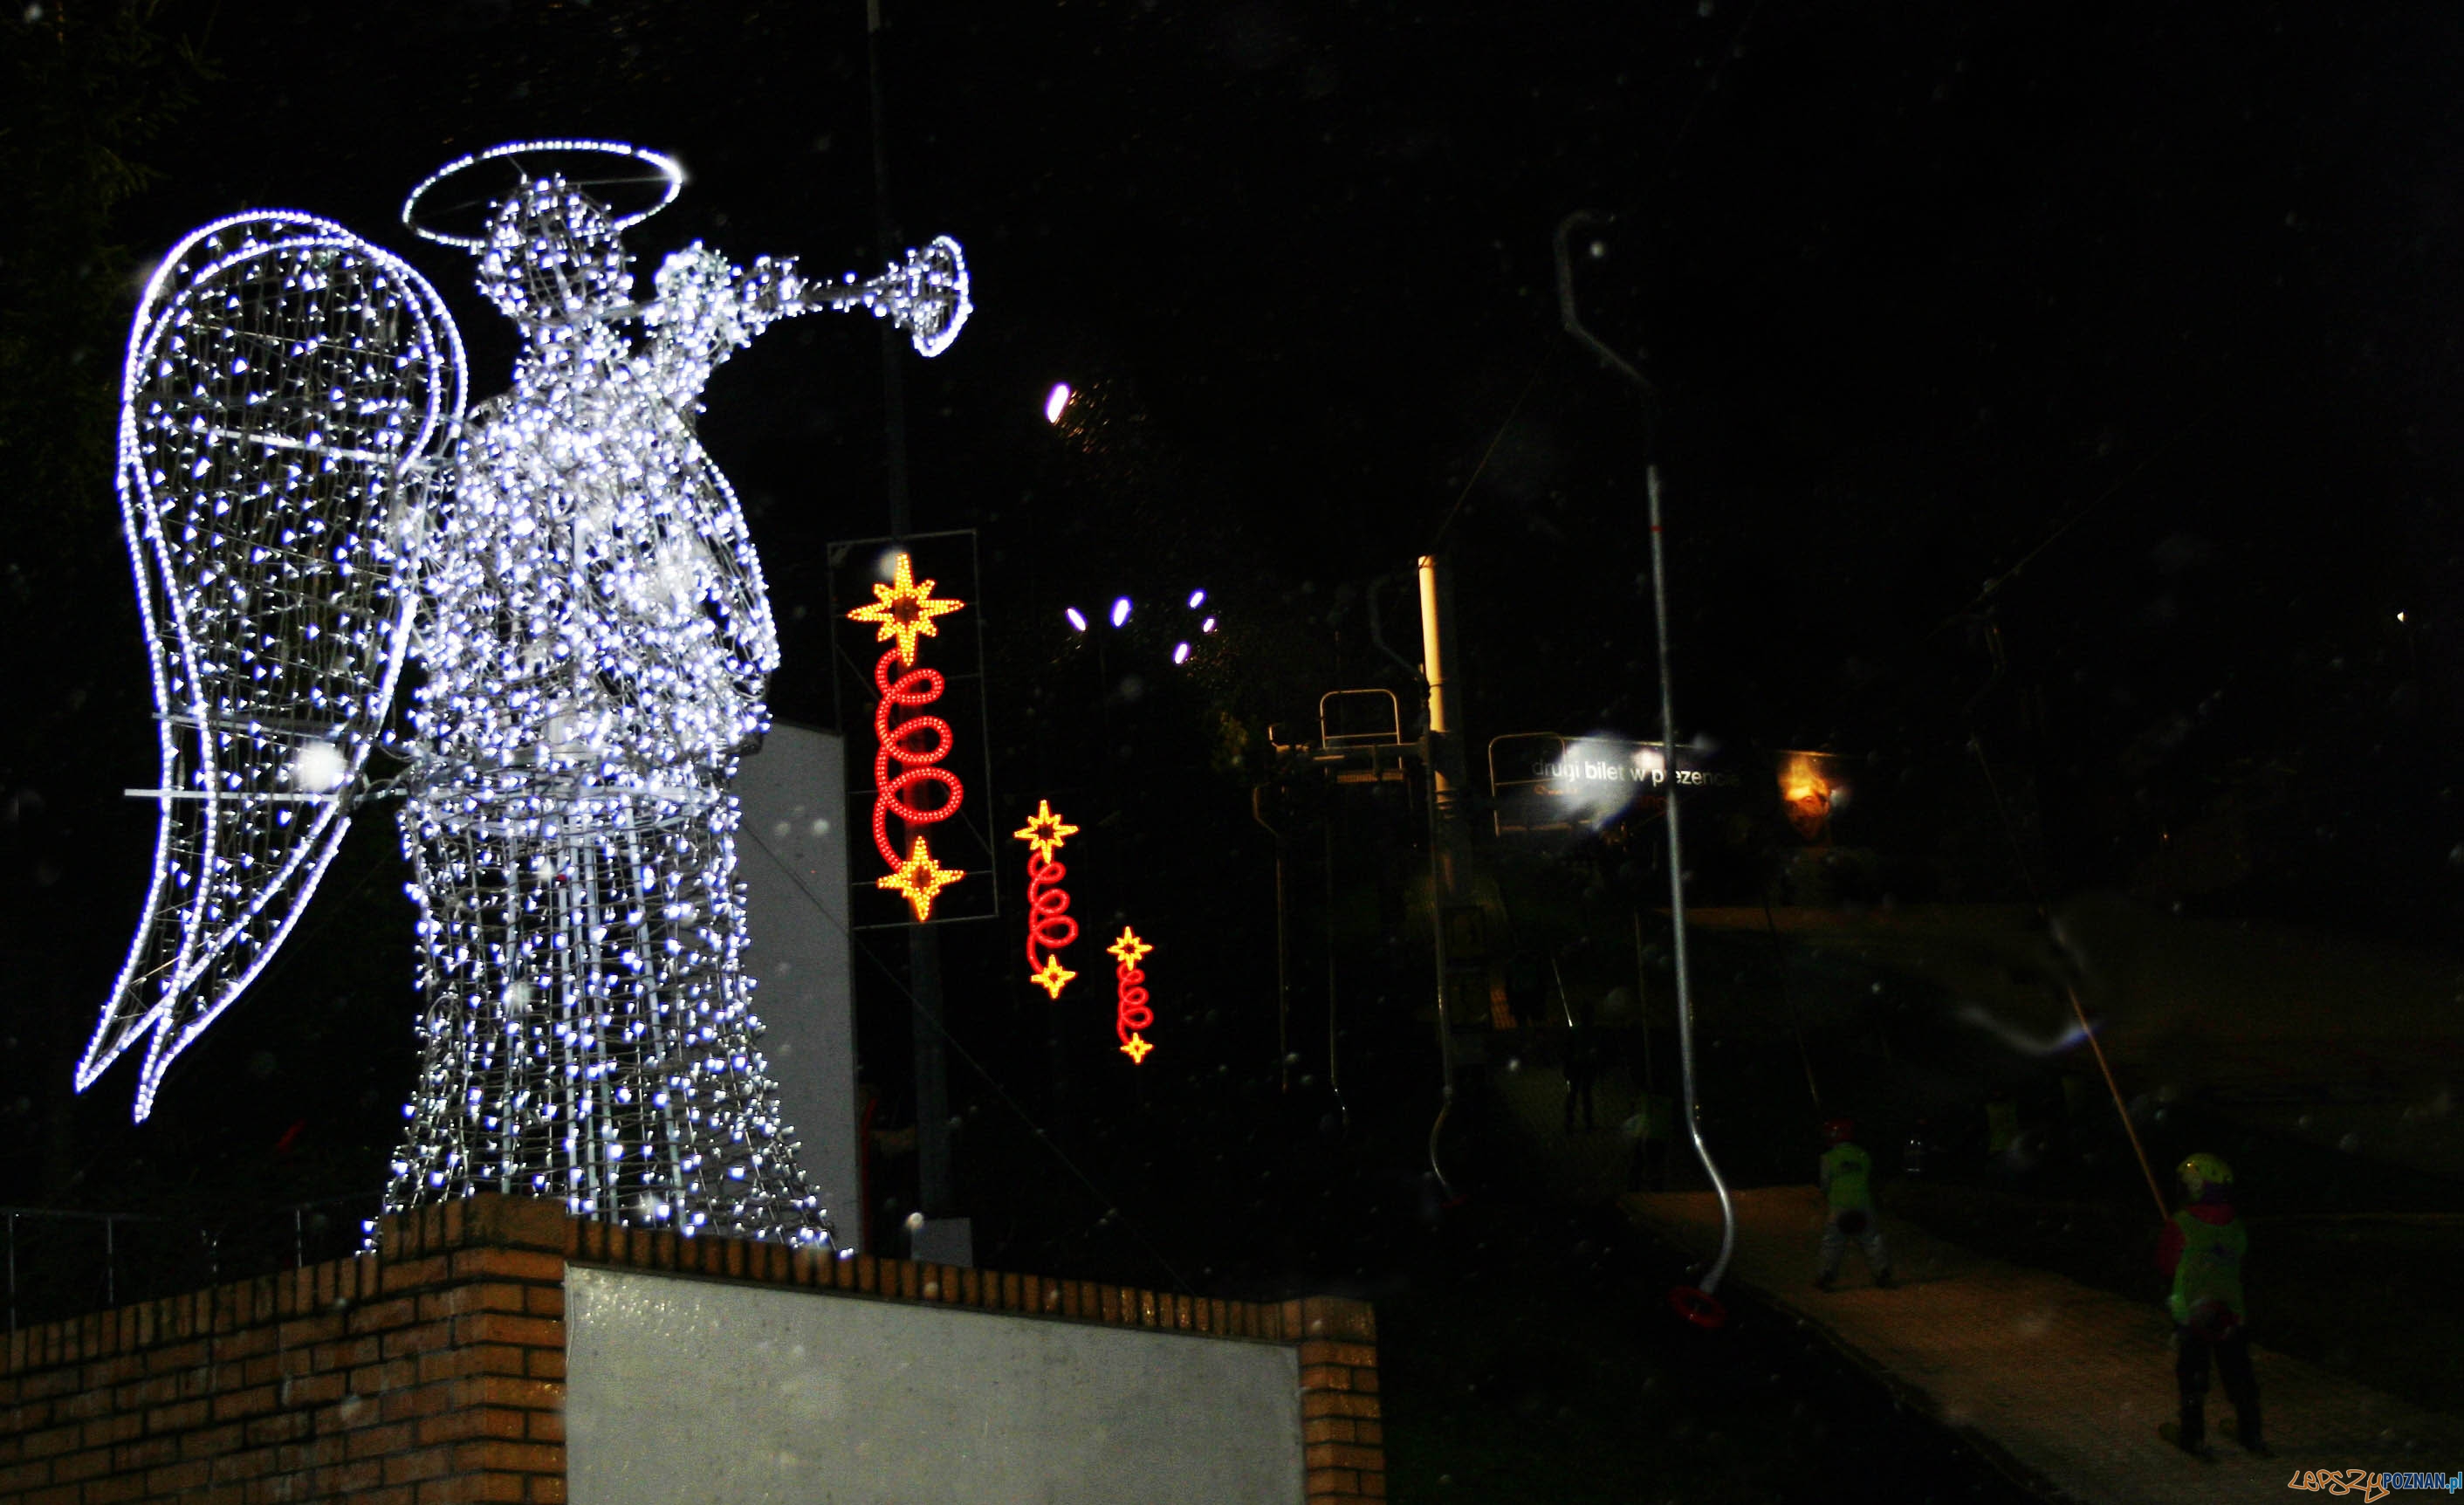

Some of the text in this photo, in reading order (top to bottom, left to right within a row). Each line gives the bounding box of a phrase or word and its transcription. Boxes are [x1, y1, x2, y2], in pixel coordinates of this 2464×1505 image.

[1532, 757, 1580, 782] drugi
[1584, 760, 1625, 780] bilet
[1630, 767, 1646, 782] w
